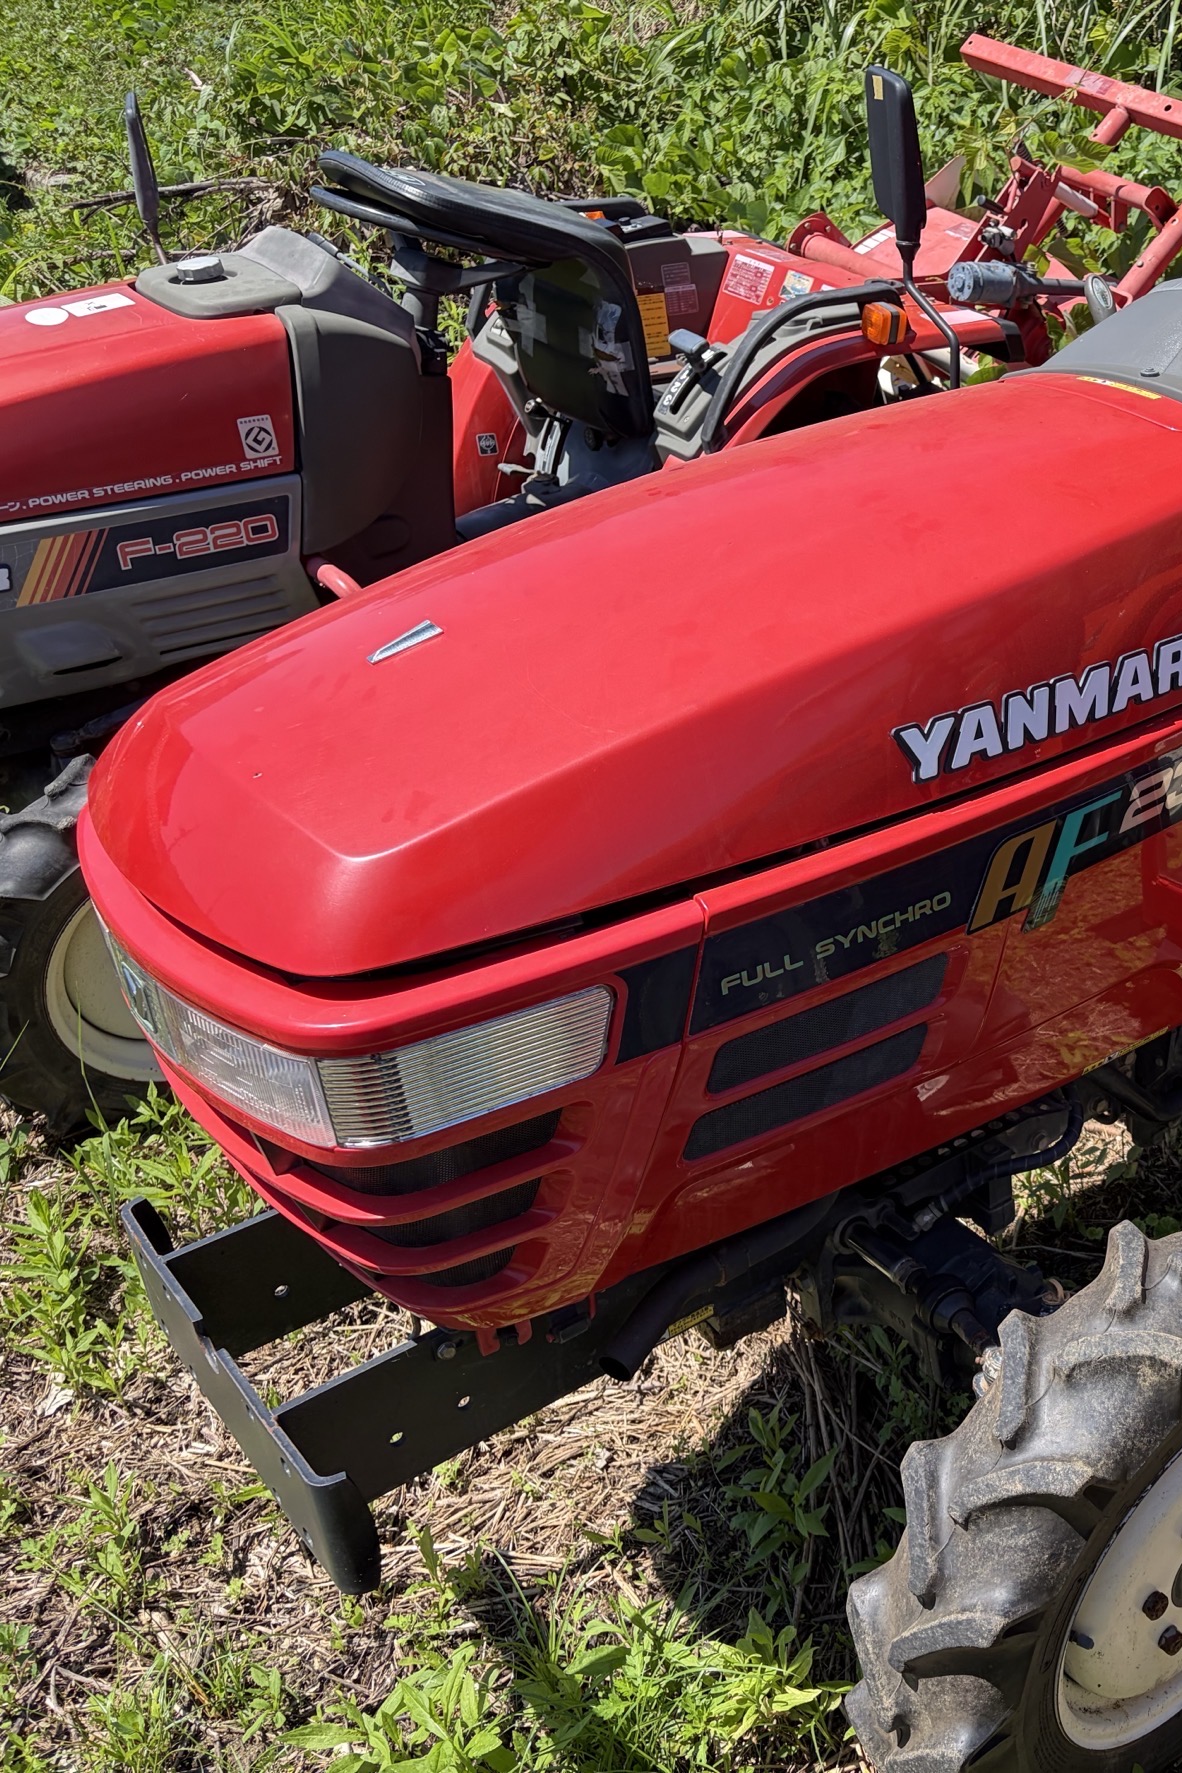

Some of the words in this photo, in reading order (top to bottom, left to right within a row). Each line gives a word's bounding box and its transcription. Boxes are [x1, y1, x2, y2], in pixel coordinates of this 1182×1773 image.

[240, 455, 282, 471] SHIFT
[117, 513, 279, 570] F-220
[720, 954, 804, 996] FULL
[815, 891, 951, 960] SYNCHRO
